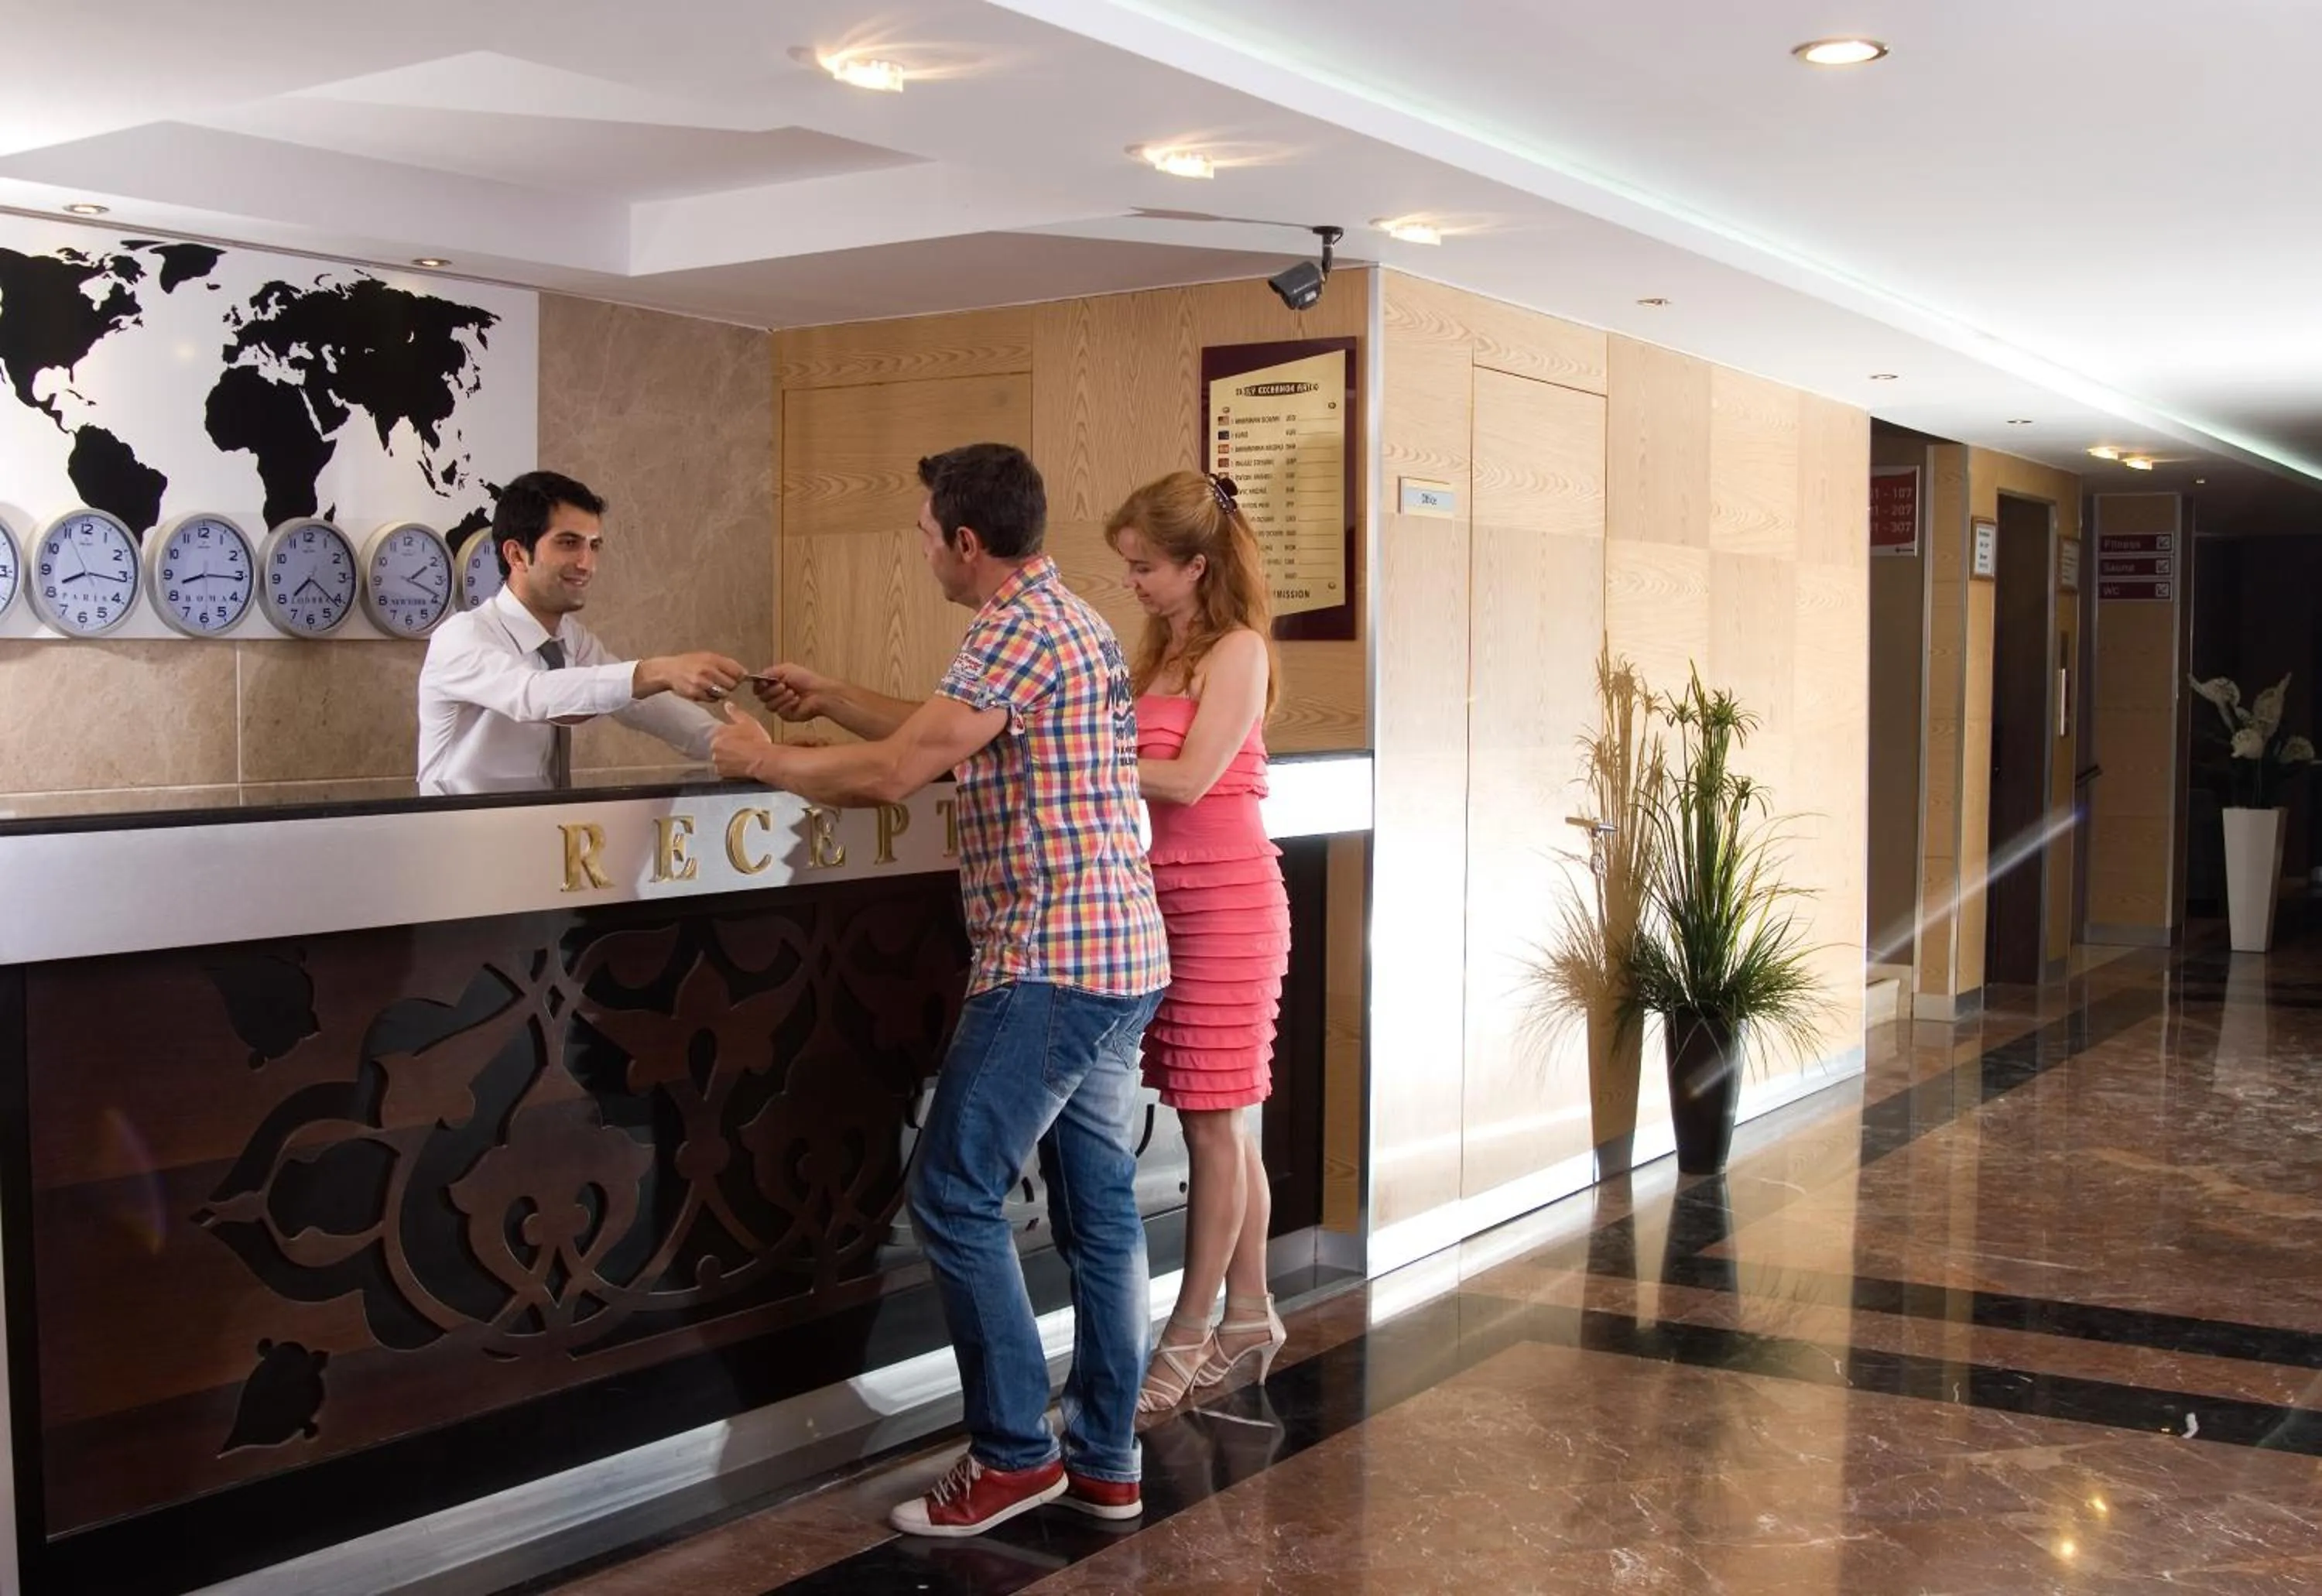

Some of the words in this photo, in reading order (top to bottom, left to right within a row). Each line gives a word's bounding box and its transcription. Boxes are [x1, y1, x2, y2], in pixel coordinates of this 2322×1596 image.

[1892, 487, 1913, 499] 107
[1891, 504, 1913, 516] 207
[80, 523, 94, 535] 12
[198, 528, 210, 538] 12
[1890, 521, 1913, 534] 307
[104, 533, 108, 543] 1
[183, 533, 190, 544] 11
[220, 534, 224, 545] 1
[303, 532, 314, 543] 12
[403, 536, 413, 546] 12
[48, 543, 60, 554] 10
[289, 538, 296, 549] 11
[324, 538, 327, 549] 1
[390, 542, 396, 552] 11
[422, 542, 425, 553] 1
[112, 550, 123, 561] 2
[170, 549, 179, 560] 10
[228, 550, 238, 561] 2
[484, 545, 490, 555] 11
[276, 553, 286, 564] 10
[333, 553, 341, 564] 2
[379, 557, 387, 567] 10
[430, 557, 438, 567] 2
[472, 558, 481, 568] 10
[41, 563, 51, 575] 9
[118, 570, 128, 582] 3
[163, 569, 173, 581] 9
[235, 570, 244, 581] 3
[272, 574, 281, 584] 9
[338, 573, 347, 583] 3
[373, 575, 382, 586] 9
[435, 575, 443, 585] 3
[467, 577, 475, 587] 9
[46, 587, 57, 598] 8
[169, 591, 179, 601] 8
[2104, 586, 2120, 595] WC
[111, 592, 122, 604] 4
[230, 591, 238, 602] 4
[277, 594, 286, 604] 8
[334, 594, 341, 604] 4
[378, 595, 387, 605] 8
[430, 594, 440, 604] 4
[471, 595, 479, 605] 8
[59, 604, 68, 615] 7
[98, 607, 108, 618] 5
[182, 606, 190, 617] 7
[217, 606, 227, 617] 5
[290, 608, 298, 619] 7
[322, 608, 331, 618] 5
[390, 610, 397, 619] 7
[420, 609, 427, 619] 5
[77, 611, 87, 623] 6
[199, 613, 209, 623] 6
[306, 615, 314, 625] 6
[405, 615, 413, 625] 6
